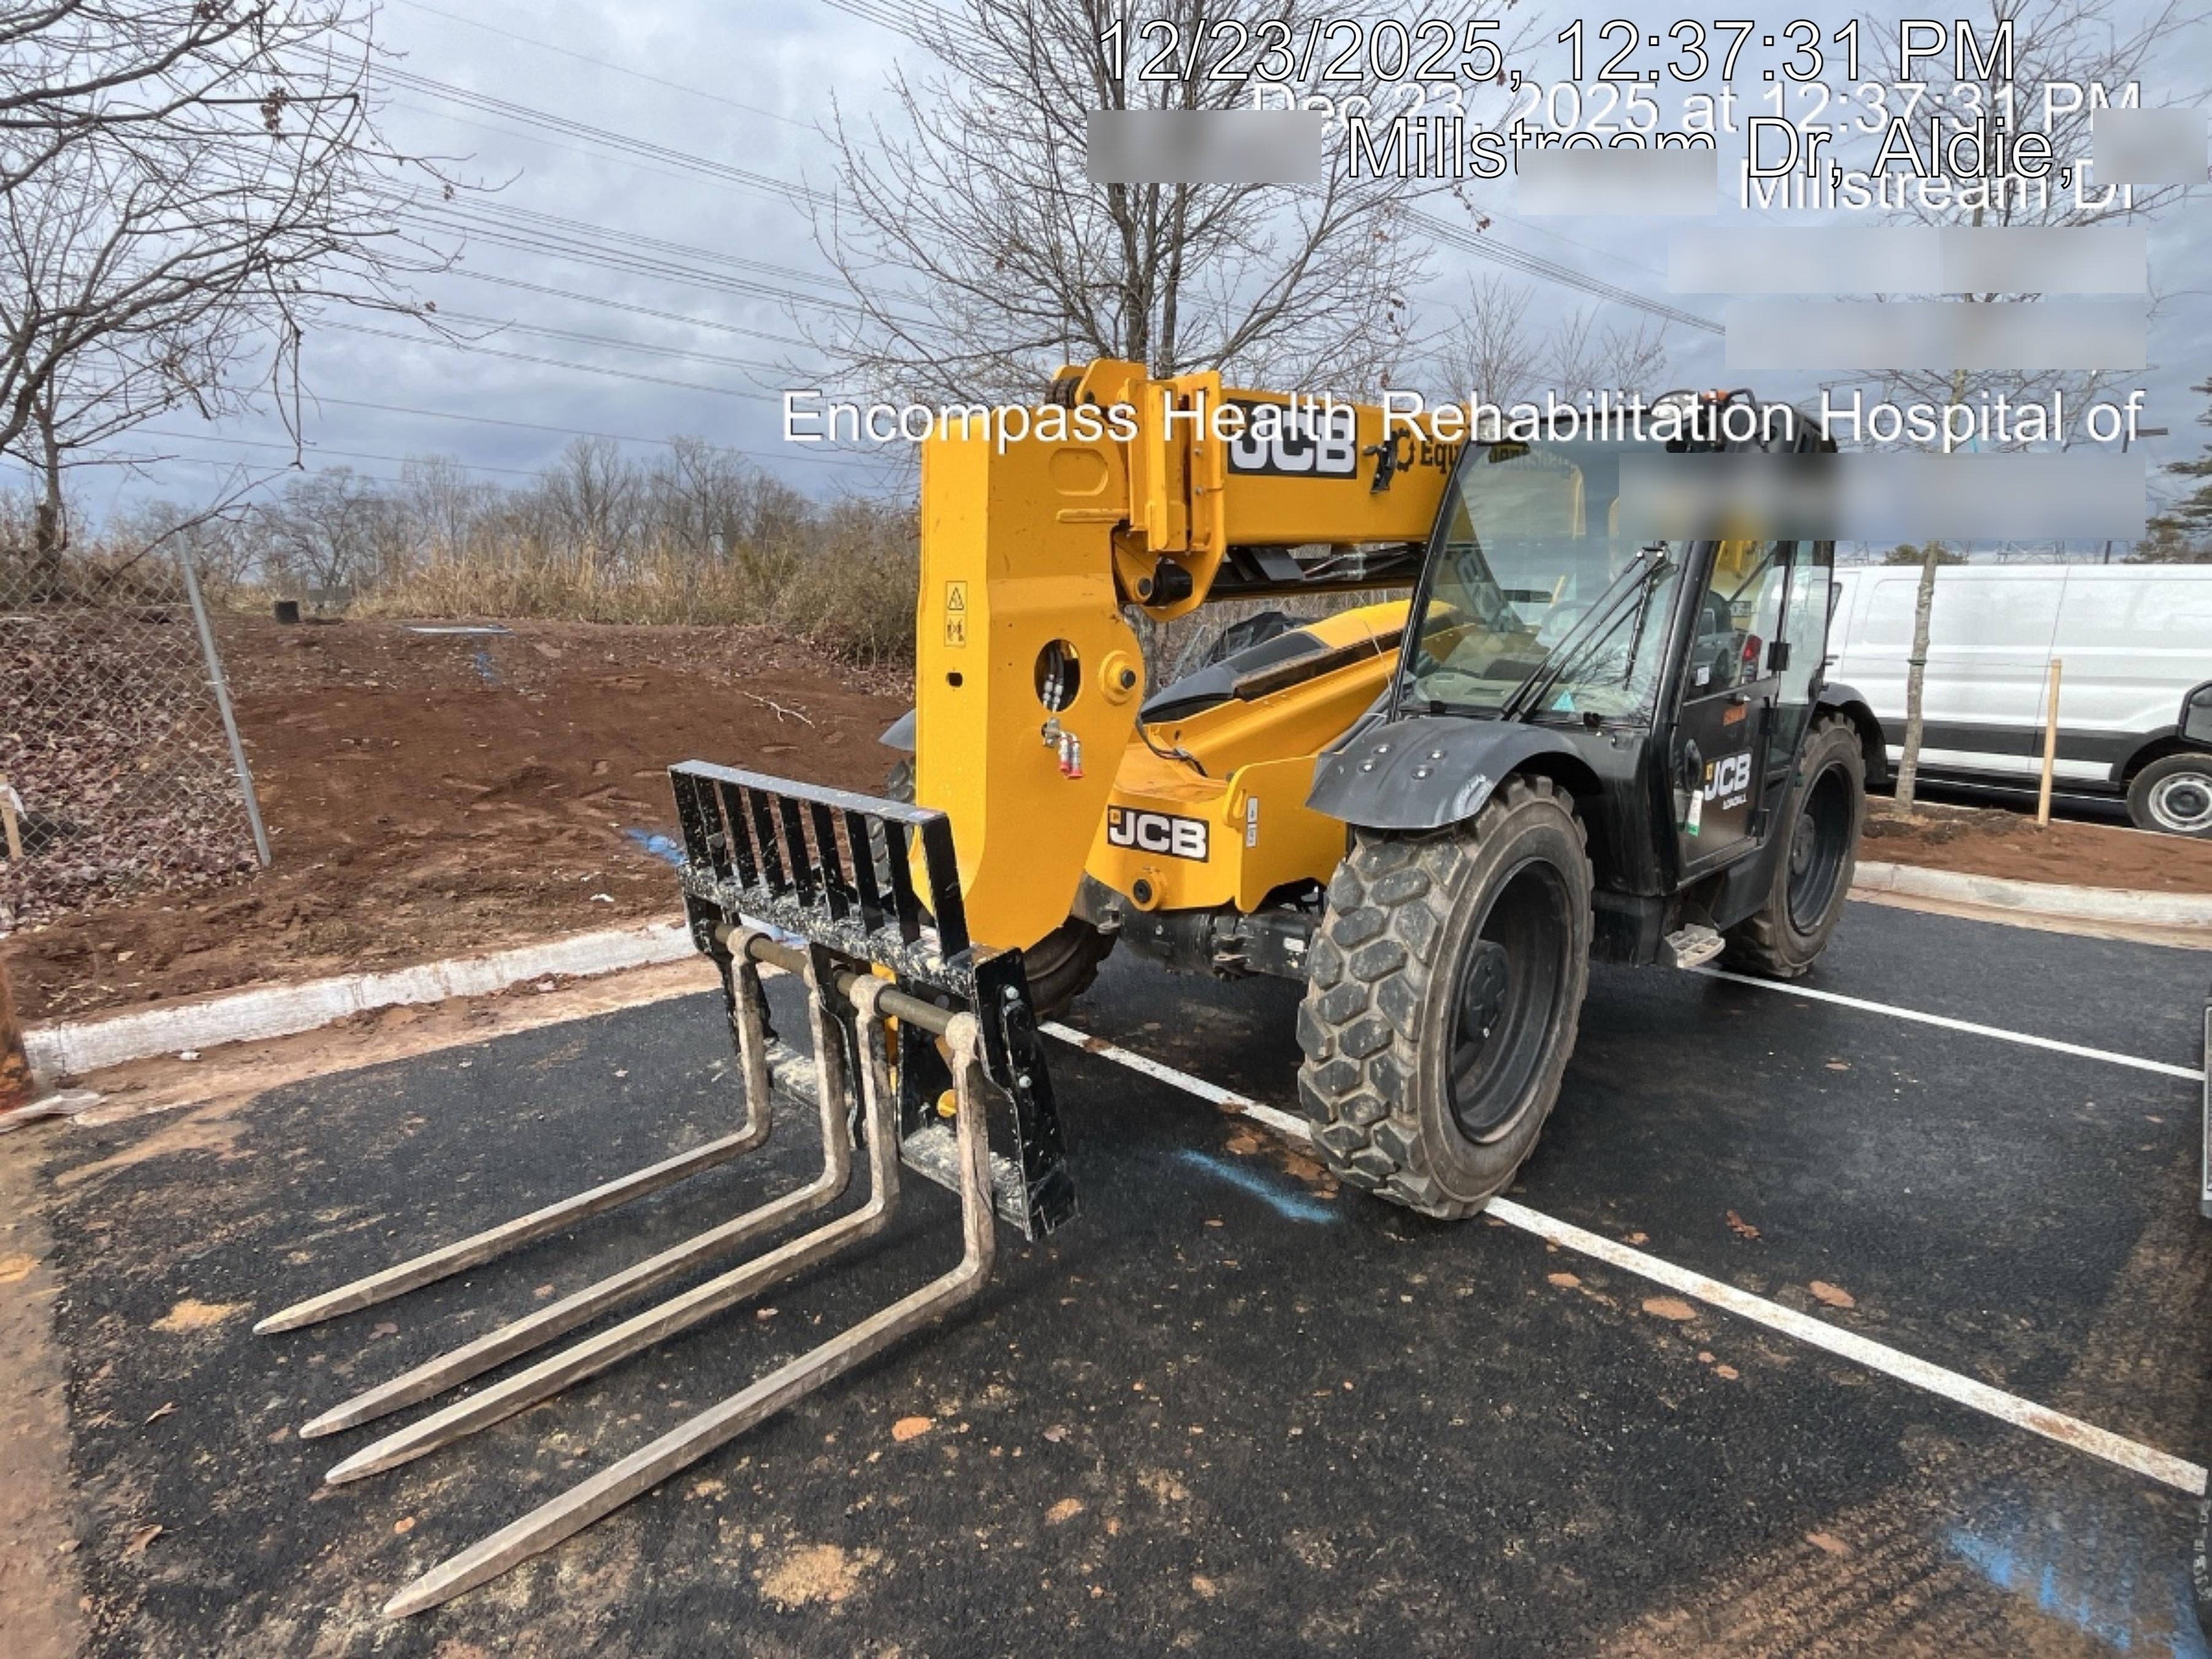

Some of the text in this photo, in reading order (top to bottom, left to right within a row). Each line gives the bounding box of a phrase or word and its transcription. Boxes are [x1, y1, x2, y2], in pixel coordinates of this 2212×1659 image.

[1231, 409, 1355, 473] JCB
[1704, 753, 1751, 801] JCB
[1110, 811, 1207, 859] JCB
